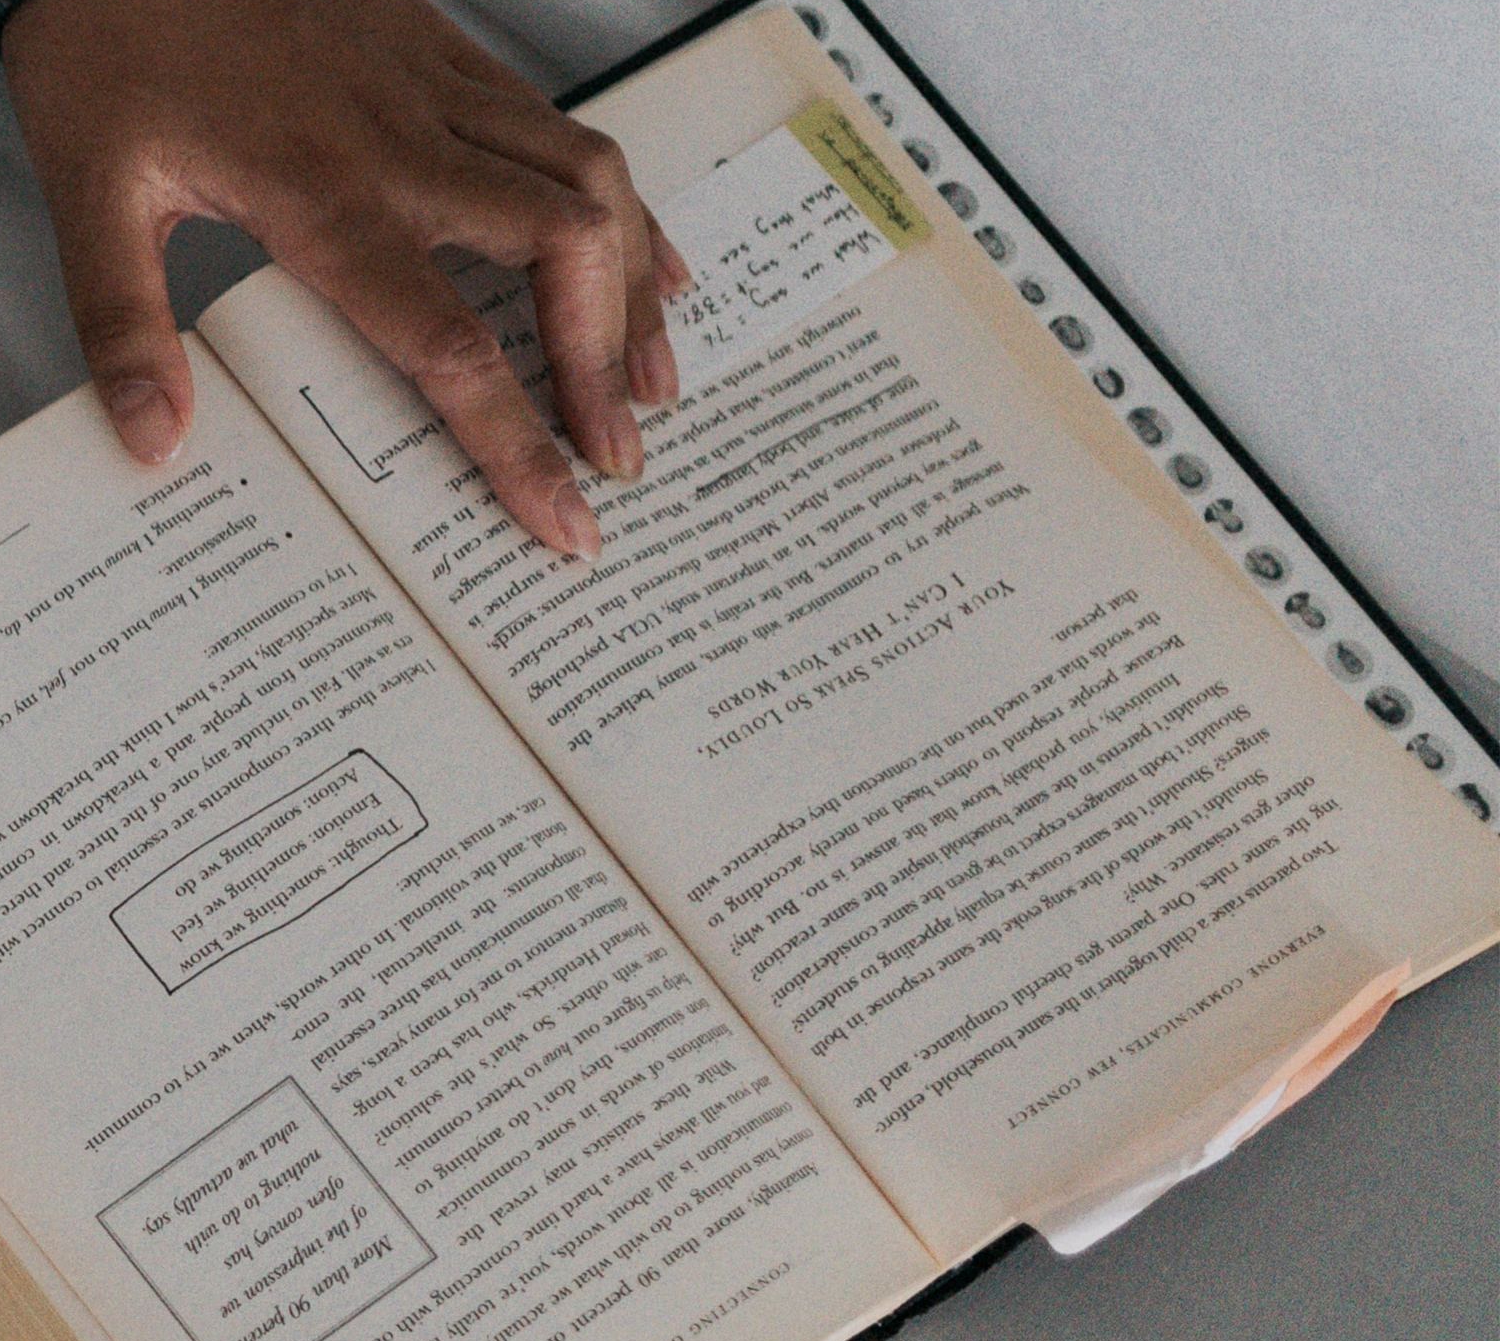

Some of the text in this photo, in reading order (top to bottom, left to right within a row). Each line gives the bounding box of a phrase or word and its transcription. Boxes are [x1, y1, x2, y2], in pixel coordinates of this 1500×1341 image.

[798, 180, 841, 215] What
[820, 200, 860, 234] How
[785, 229, 814, 252] we
[831, 225, 882, 269] What
[745, 273, 789, 313] say
[798, 260, 824, 283] we
[173, 765, 360, 899] Action: something we do
[169, 790, 384, 945] Emotion: something we feel
[178, 816, 405, 976] Thought: something we know
[1005, 922, 1328, 1132] EVERYONE COMMUNICATES, FEW CONNECT
[140, 1118, 301, 1238] what we actually say.
[182, 1147, 324, 1257] nothing to do with
[222, 1173, 346, 1272] often convey has
[349, 1232, 395, 1271] More
[218, 1202, 370, 1320] of the impression we
[310, 1263, 352, 1299] than
[286, 1292, 313, 1321] 90
[687, 1260, 792, 1338] CONNECTING
